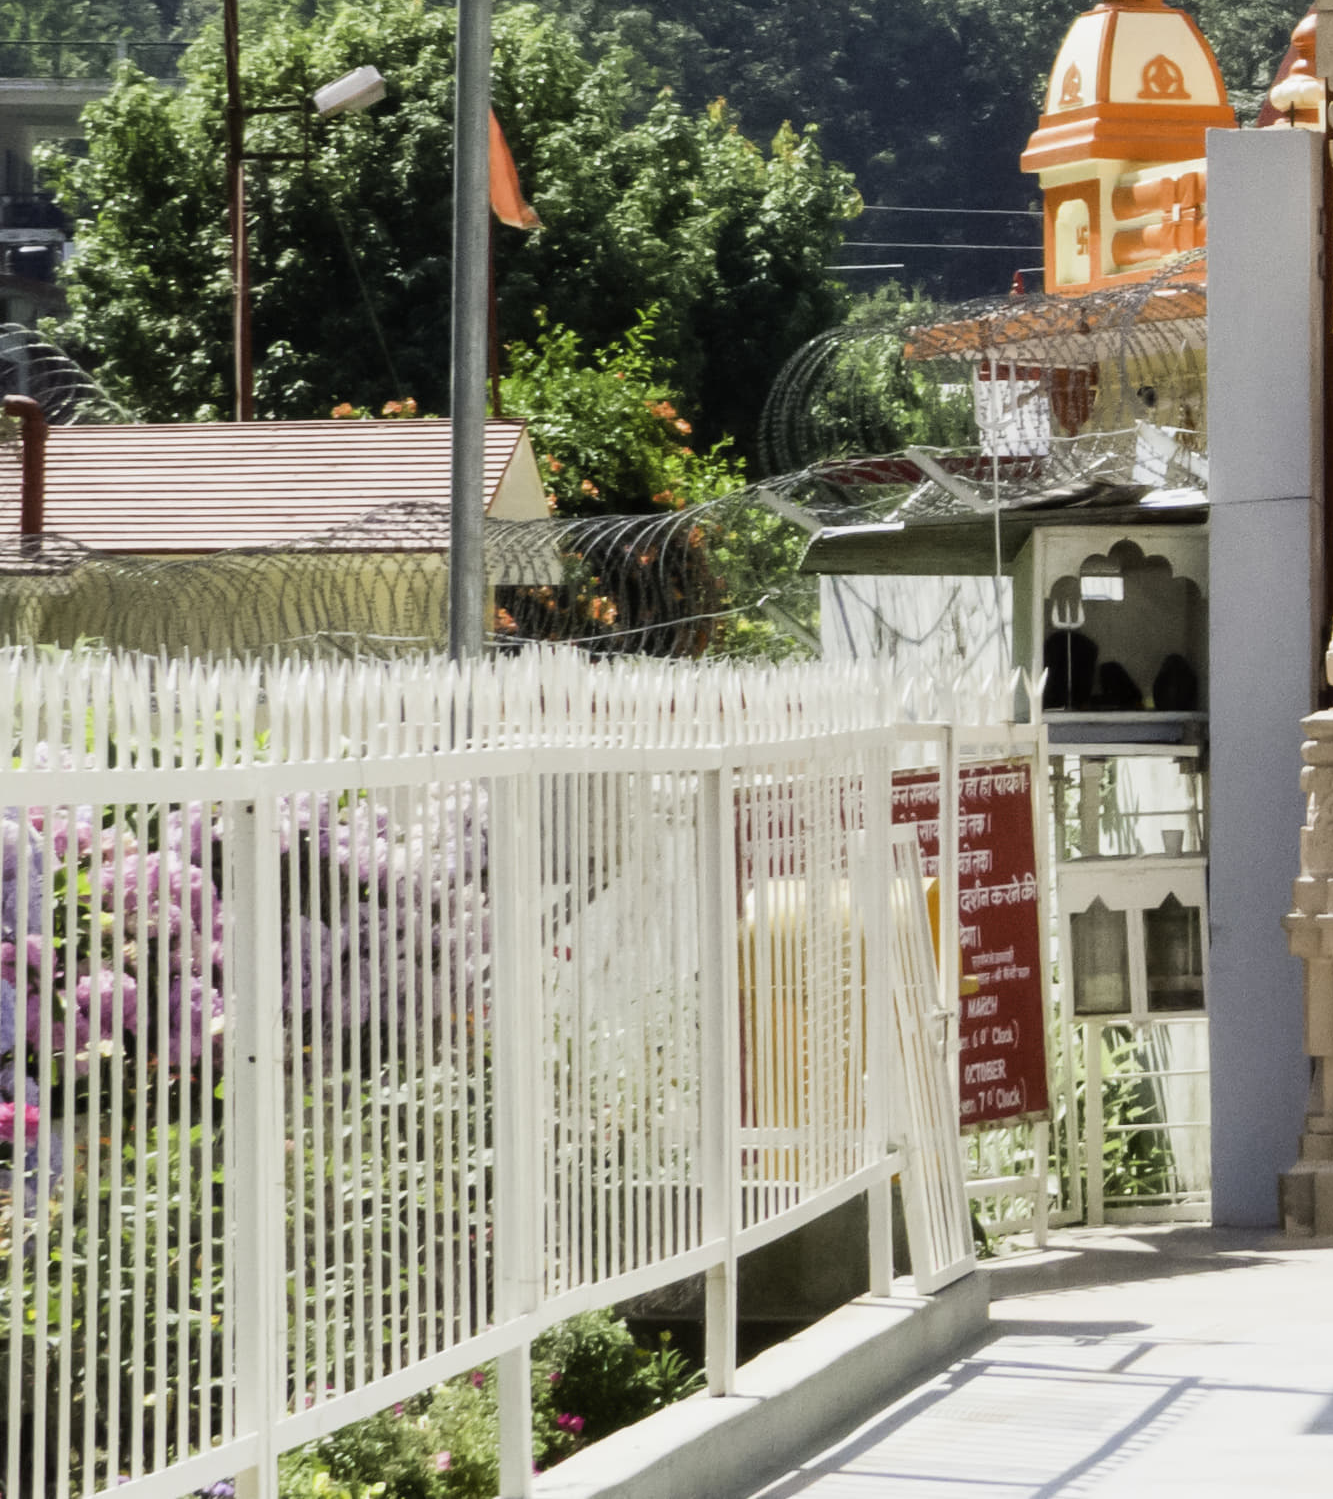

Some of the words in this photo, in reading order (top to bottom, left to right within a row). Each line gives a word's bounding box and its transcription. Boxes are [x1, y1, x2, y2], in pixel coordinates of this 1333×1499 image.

[967, 993, 998, 1018] MARCH
[964, 1058, 1007, 1084] OCTOBER
[978, 1091, 985, 1112] 7
